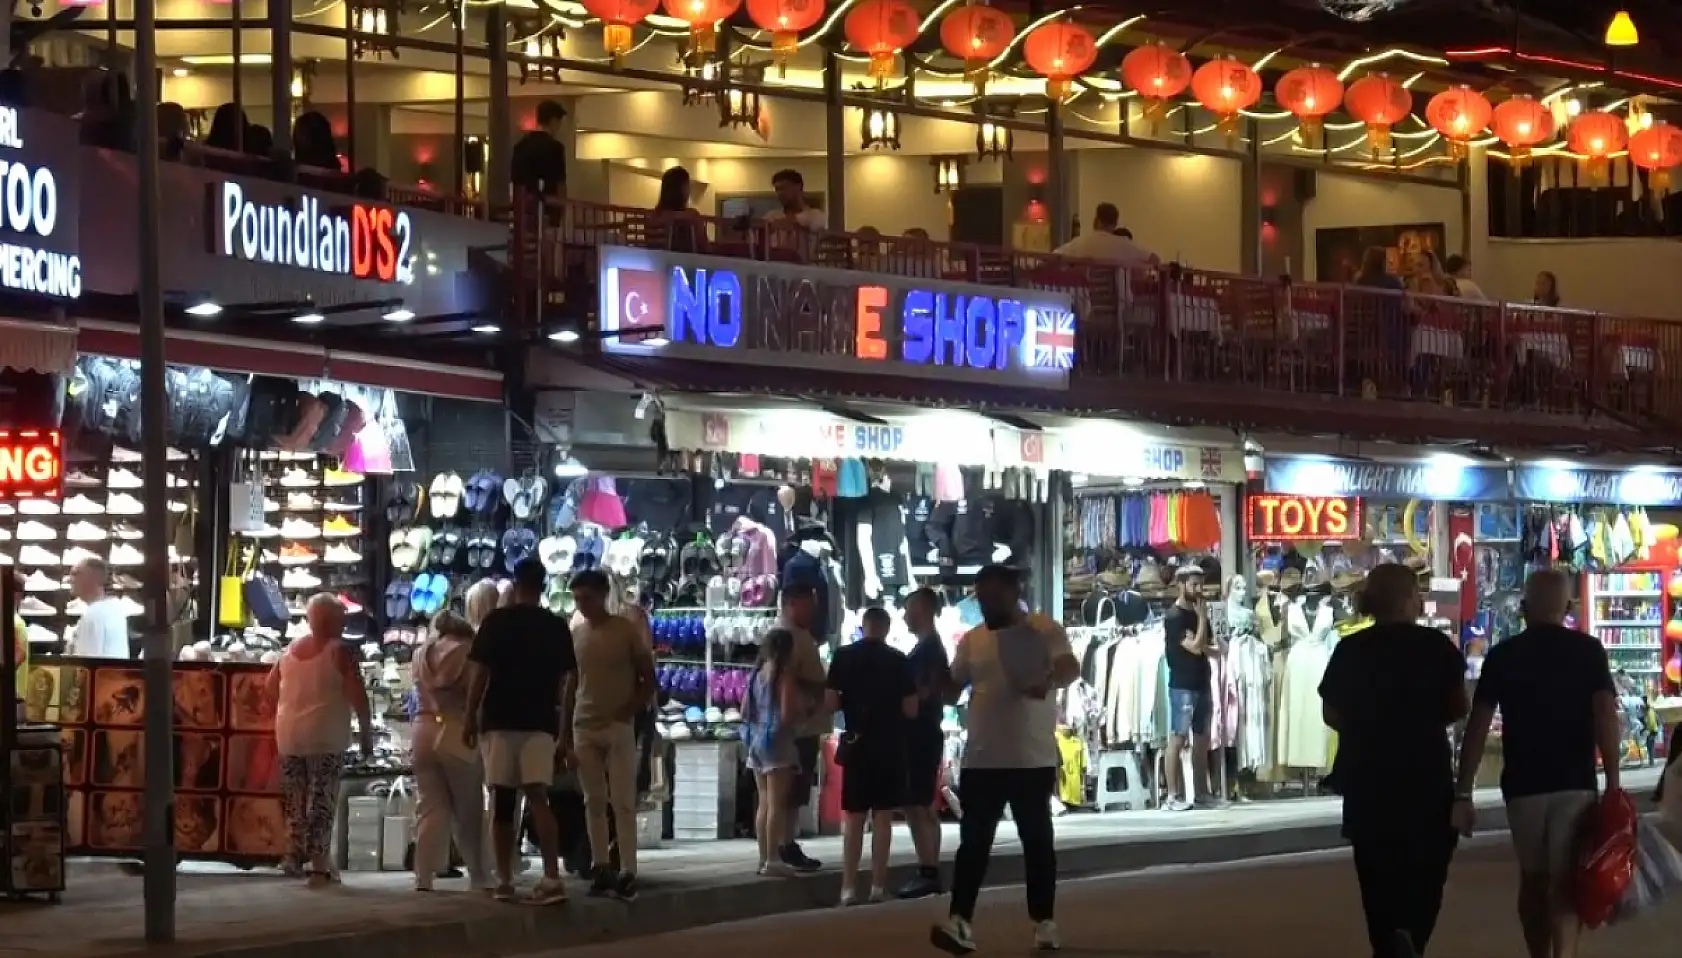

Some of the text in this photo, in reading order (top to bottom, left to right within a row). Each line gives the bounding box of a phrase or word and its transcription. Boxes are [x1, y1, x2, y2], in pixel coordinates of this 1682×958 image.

[0, 242, 81, 298] IERCING
[671, 264, 741, 347] NO
[903, 289, 1024, 370] SHOP
[854, 425, 904, 451] SHOP
[1260, 499, 1348, 533] TOYS
